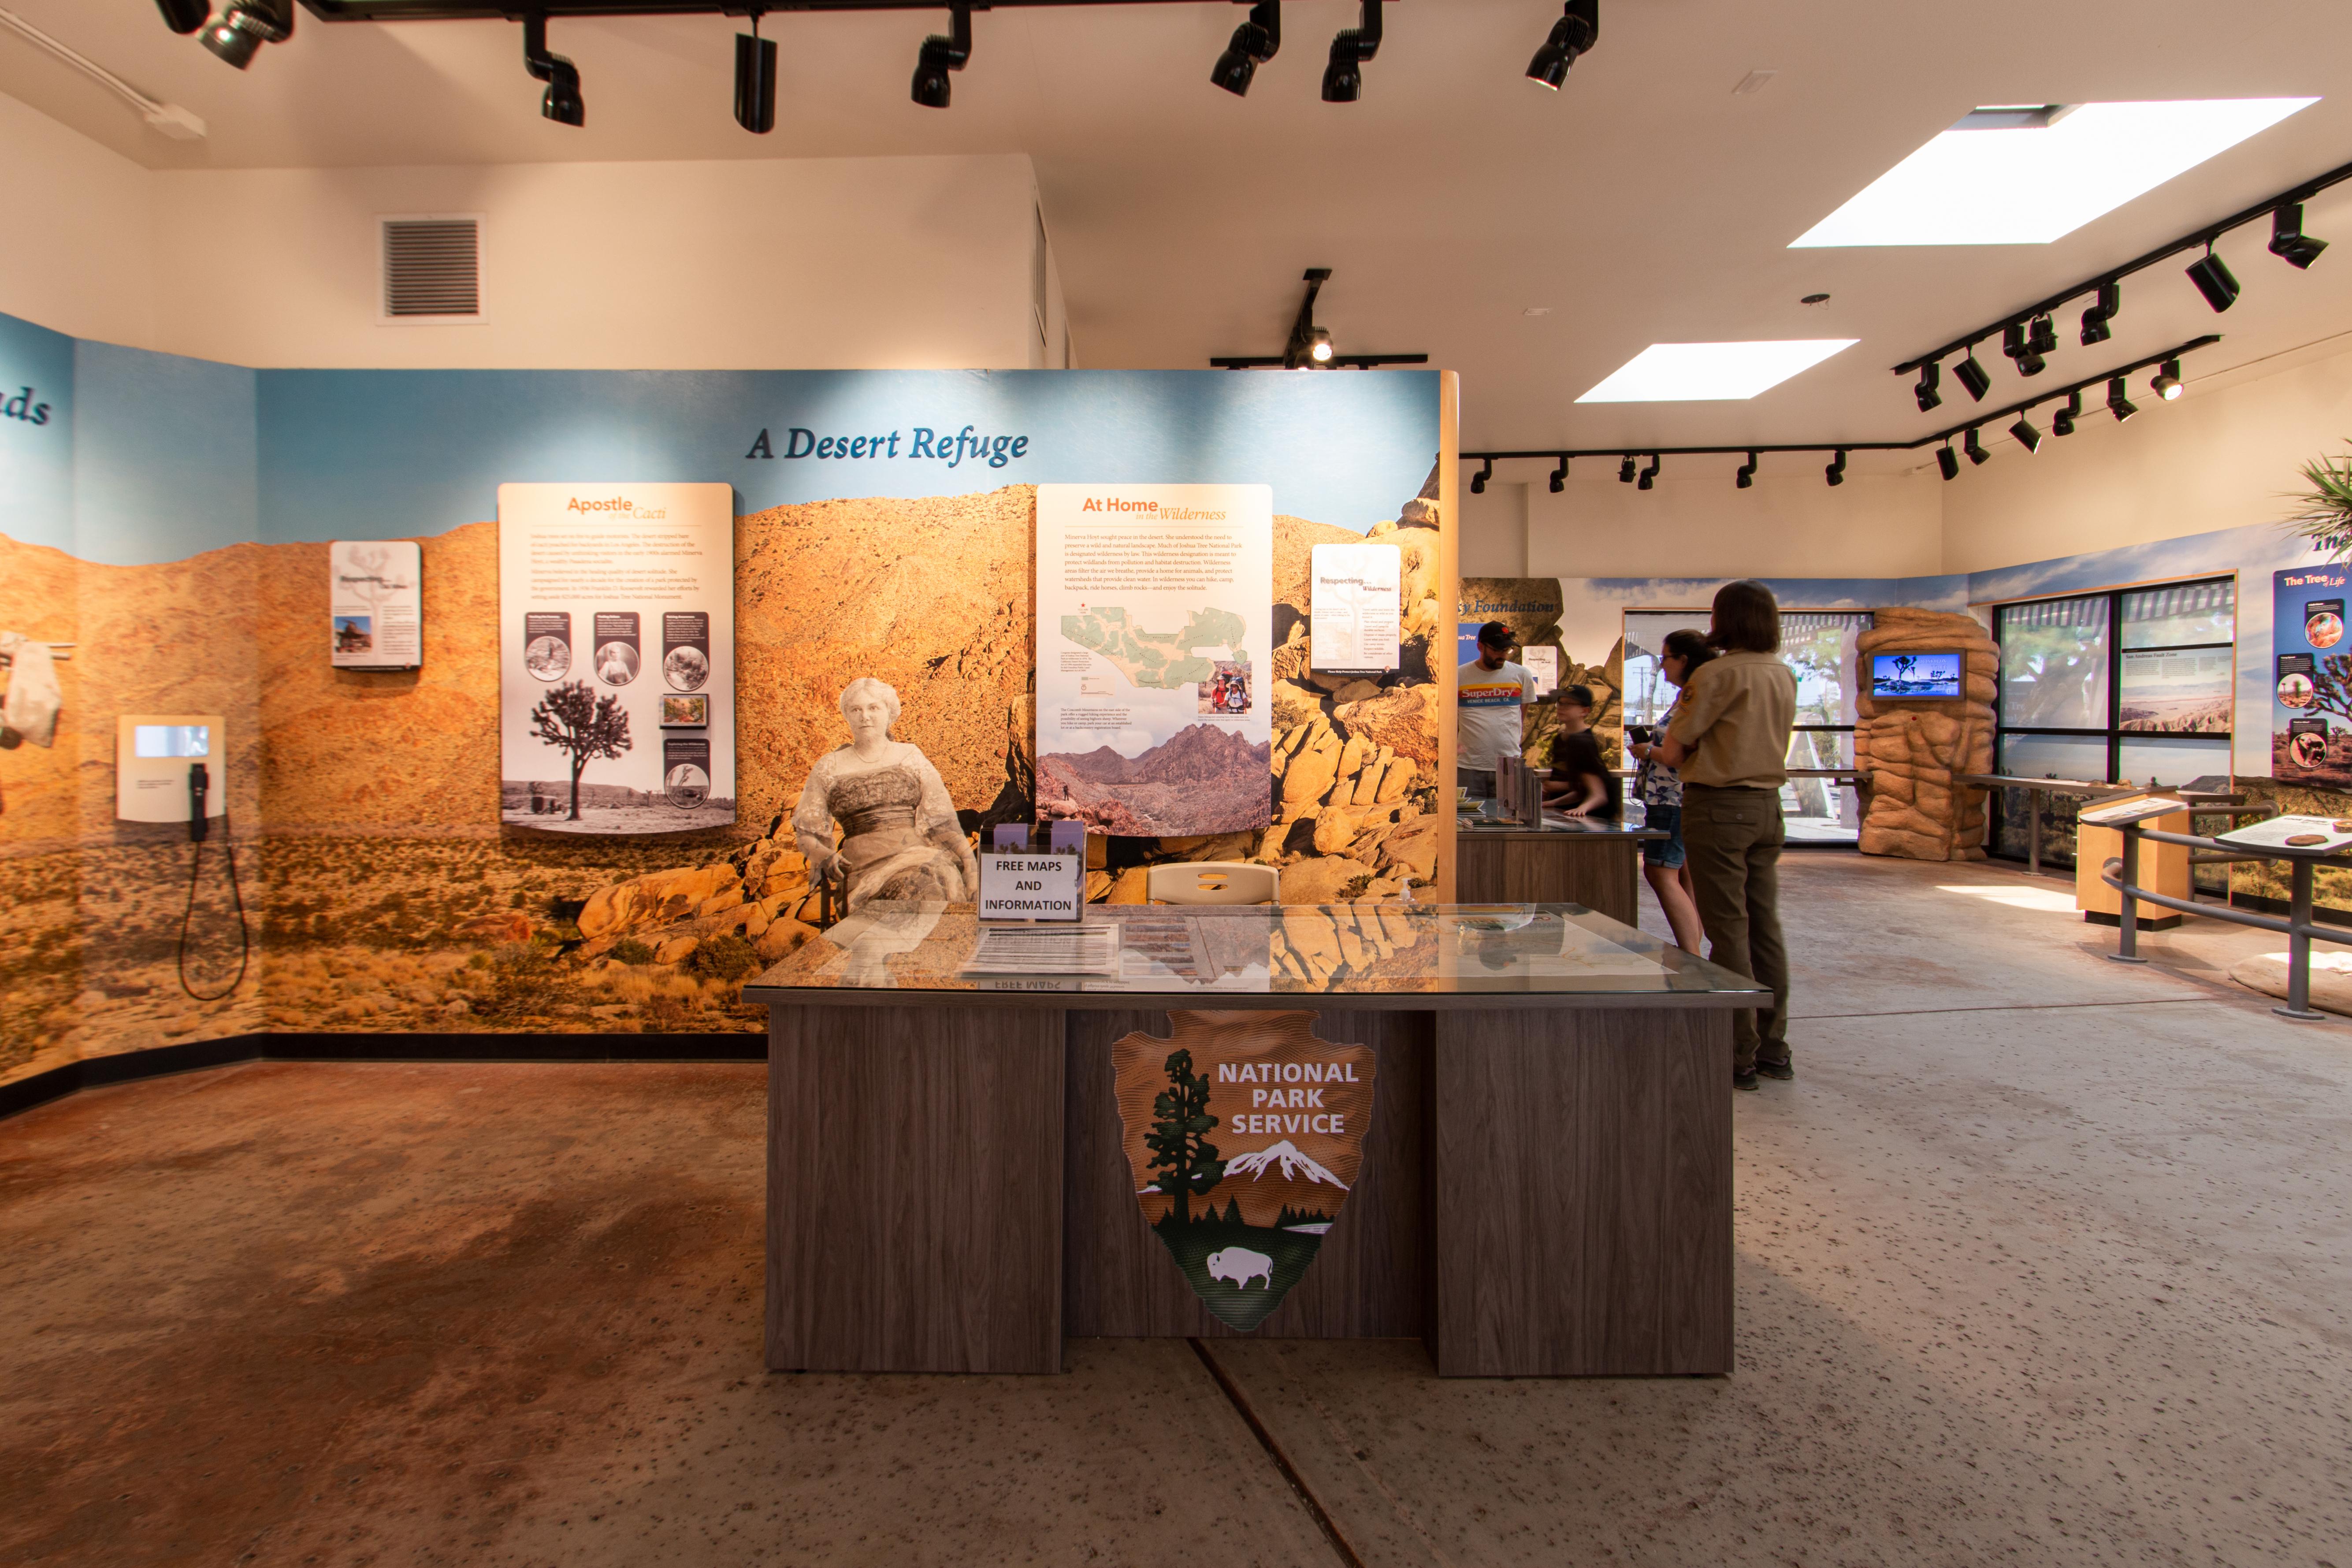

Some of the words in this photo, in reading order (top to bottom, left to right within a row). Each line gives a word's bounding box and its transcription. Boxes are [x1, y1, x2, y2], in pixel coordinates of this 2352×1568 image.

[746, 428, 774, 459] A
[784, 427, 901, 459] Desert
[909, 425, 1028, 468] Refuge
[567, 496, 632, 515] Apostle
[633, 507, 666, 519] Cacti
[1082, 498, 1102, 512] At
[1107, 498, 1158, 512] Home
[1159, 507, 1226, 520] Wilderness
[2284, 577, 2304, 586] The
[2305, 575, 2328, 584] Tree
[2330, 576, 2346, 587] Life
[1474, 599, 1554, 613] Foundation
[1462, 687, 1512, 698] SuperDry
[996, 861, 1023, 871] FREE
[1028, 861, 1062, 871] MAPS
[1015, 881, 1042, 891] AND
[985, 899, 1071, 910] INFORMATION
[1218, 1063, 1359, 1082] NATIONAL
[1253, 1089, 1324, 1108] PARK
[1232, 1114, 1344, 1133] SERVICE
